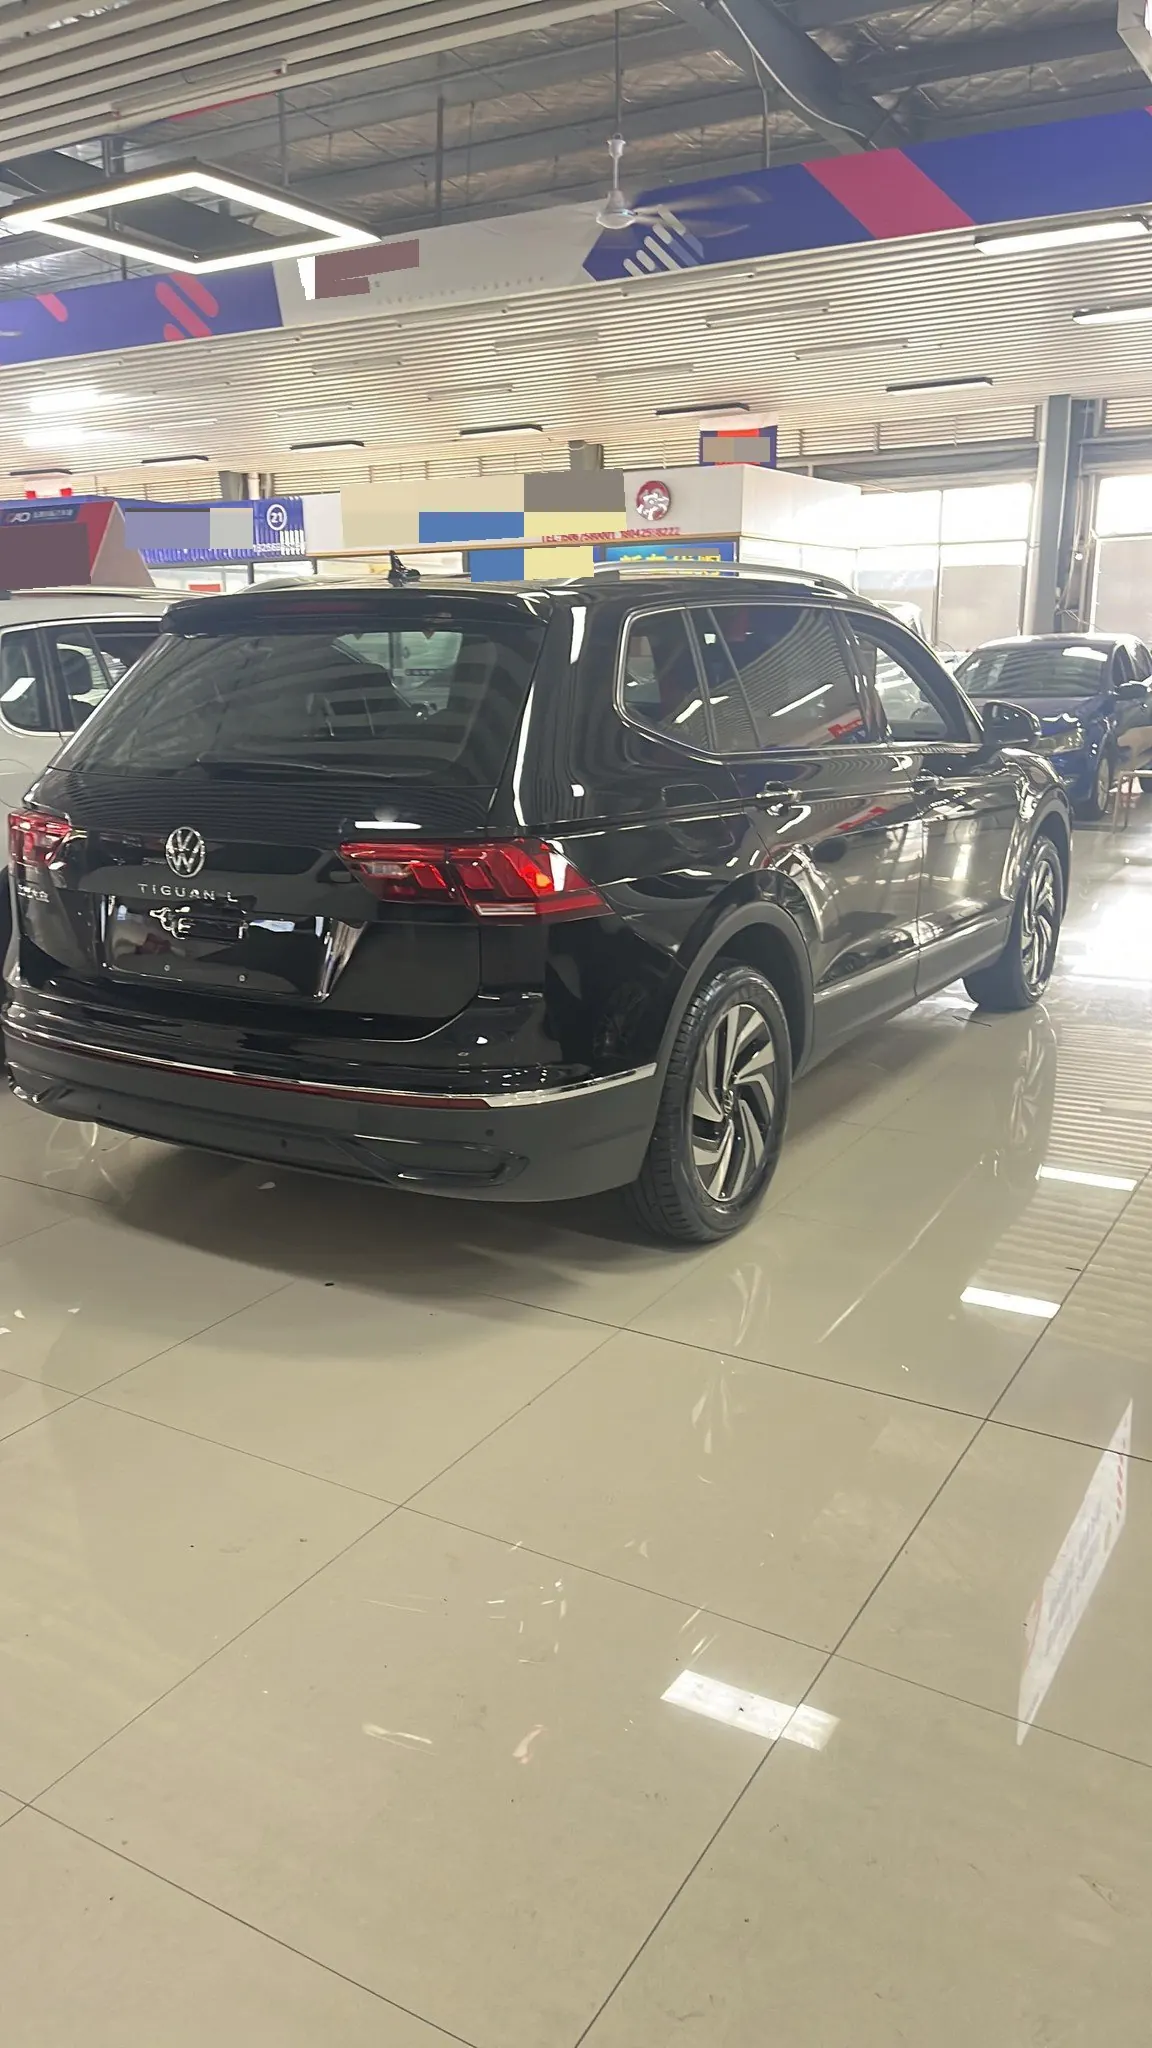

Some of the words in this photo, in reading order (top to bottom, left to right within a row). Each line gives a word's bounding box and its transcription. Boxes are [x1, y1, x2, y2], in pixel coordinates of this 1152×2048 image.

[270, 511, 284, 524] 21
[165, 826, 206, 877] VW
[138, 883, 216, 901] TIGUAN
[226, 891, 239, 903] L
